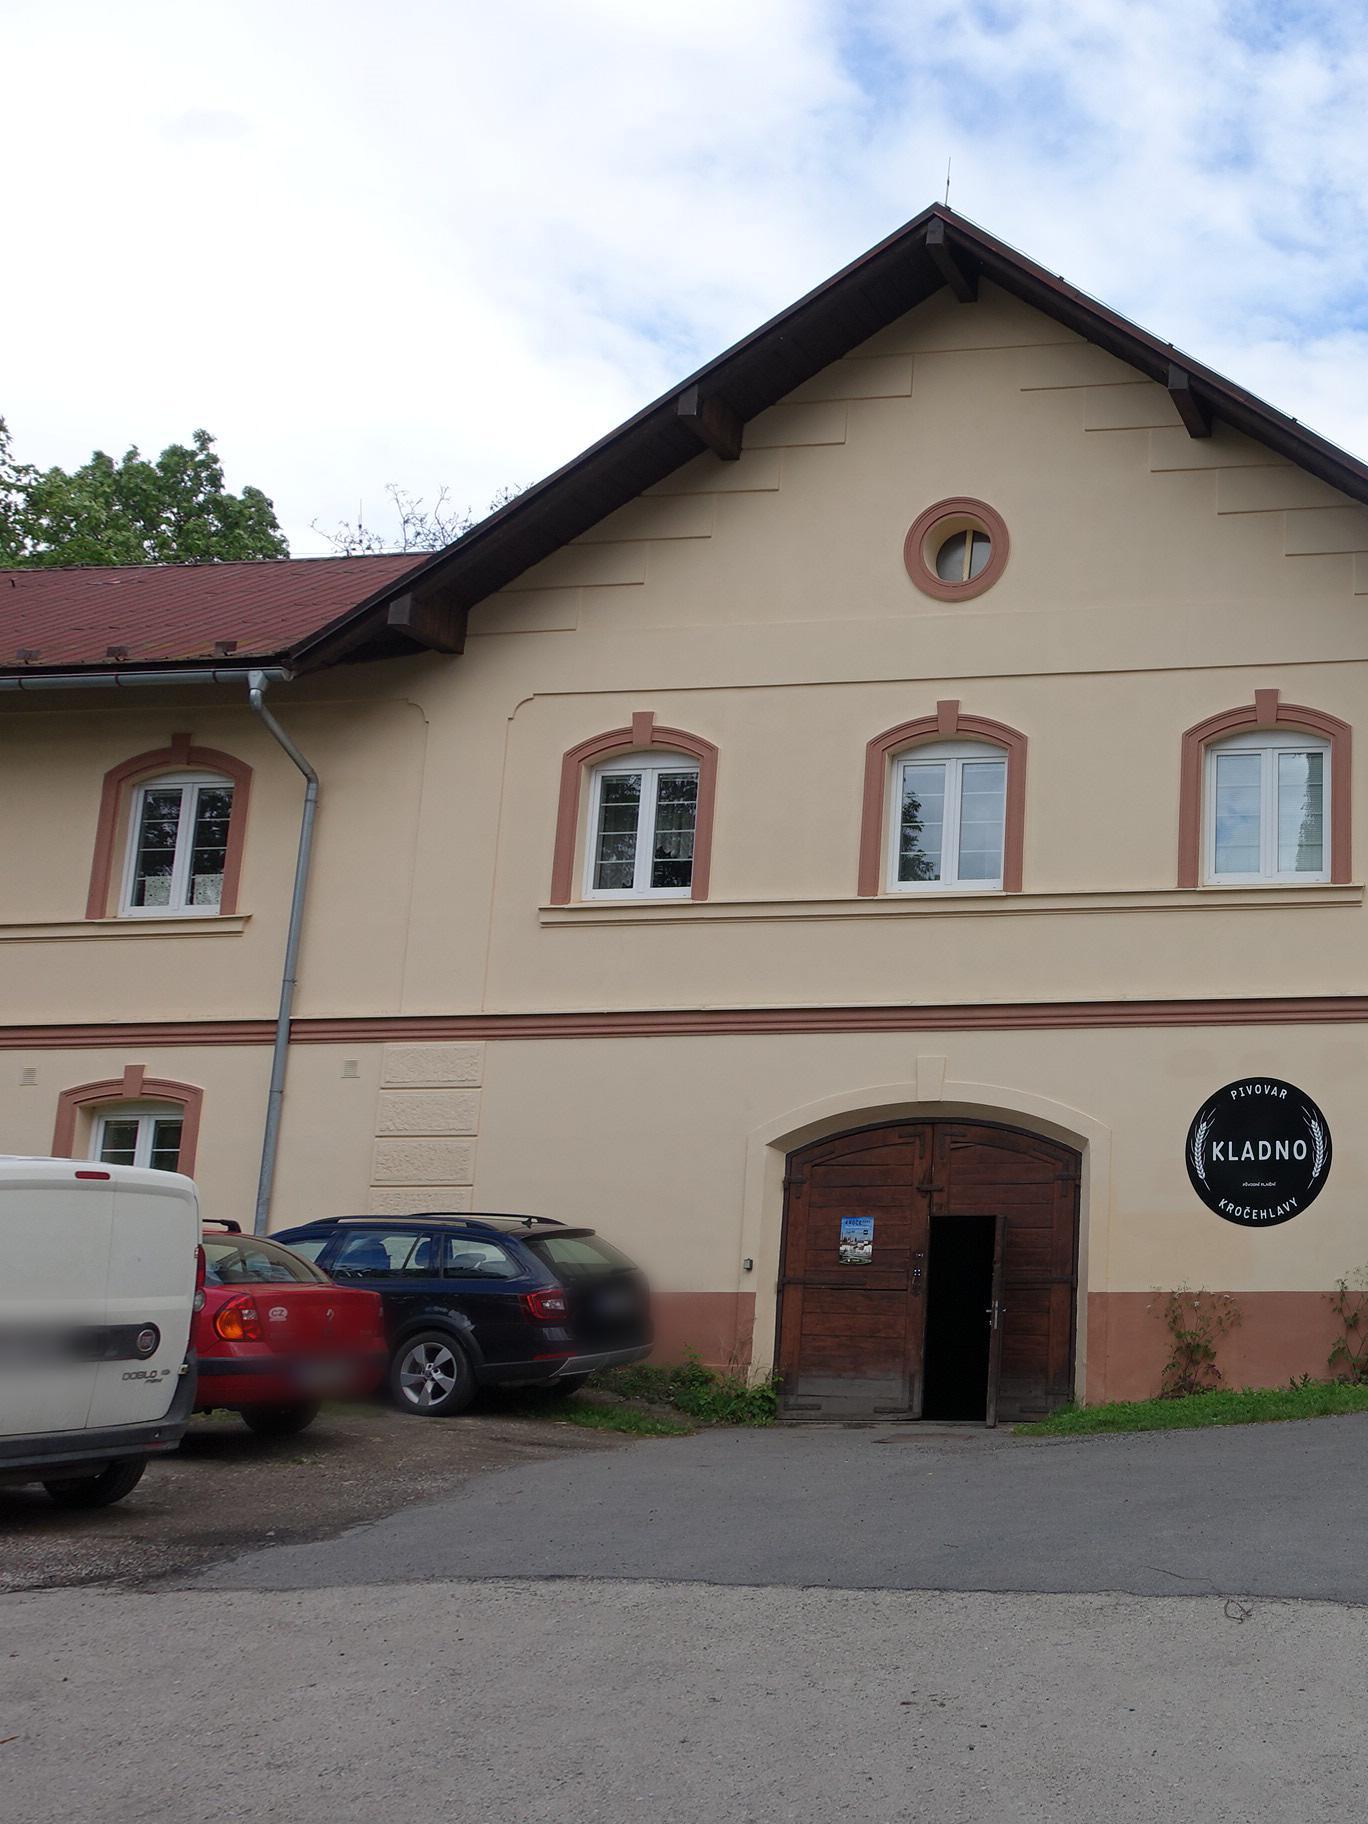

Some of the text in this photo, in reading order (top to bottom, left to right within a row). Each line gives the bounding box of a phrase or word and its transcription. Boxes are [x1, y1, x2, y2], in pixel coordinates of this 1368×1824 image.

[1230, 1084, 1288, 1100] PIVOVAR
[1212, 1139, 1307, 1161] KLADNO
[1218, 1197, 1299, 1220] KROČEHLAVY
